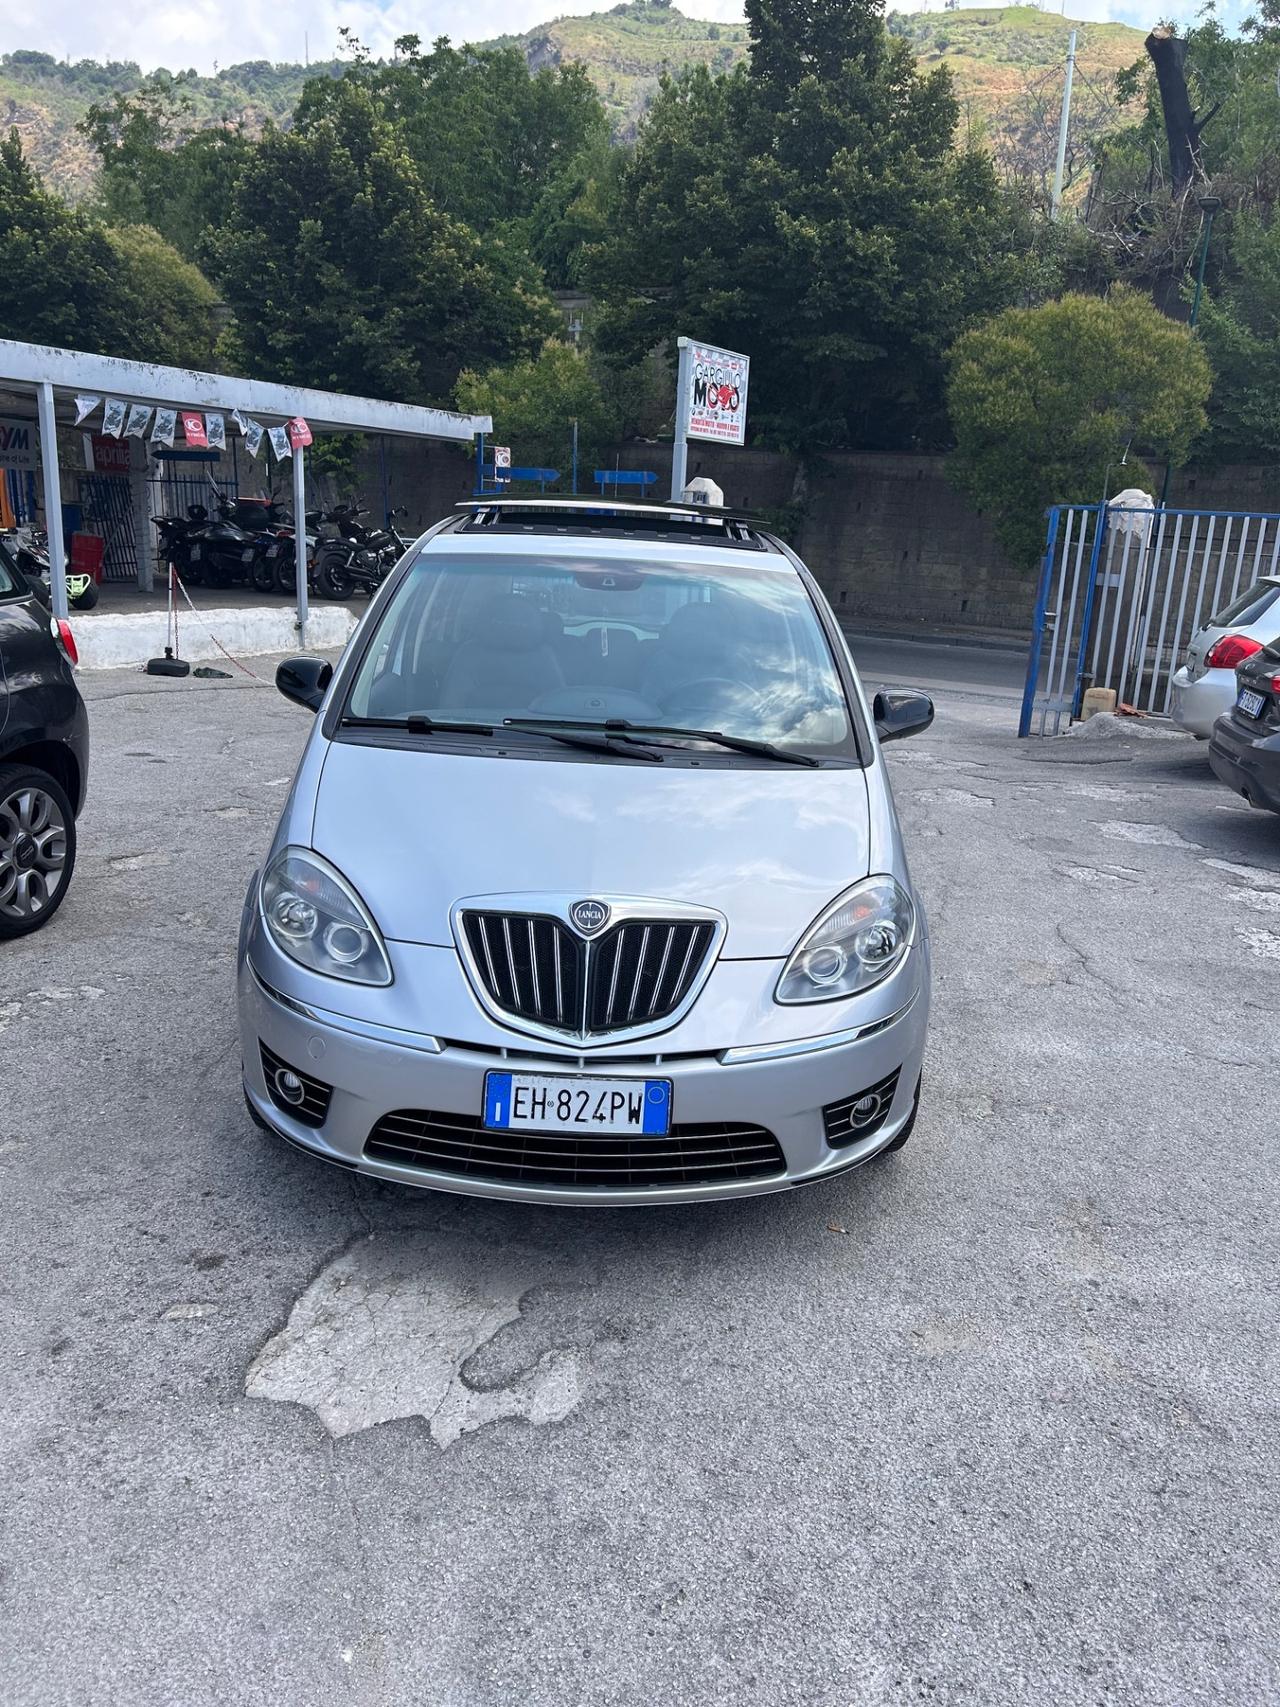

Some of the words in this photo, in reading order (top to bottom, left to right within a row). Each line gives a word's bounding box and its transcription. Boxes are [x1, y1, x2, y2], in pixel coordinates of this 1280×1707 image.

[578, 910, 602, 919] LANCIA
[513, 1086, 547, 1120] EH
[556, 1089, 643, 1125] 824PW
